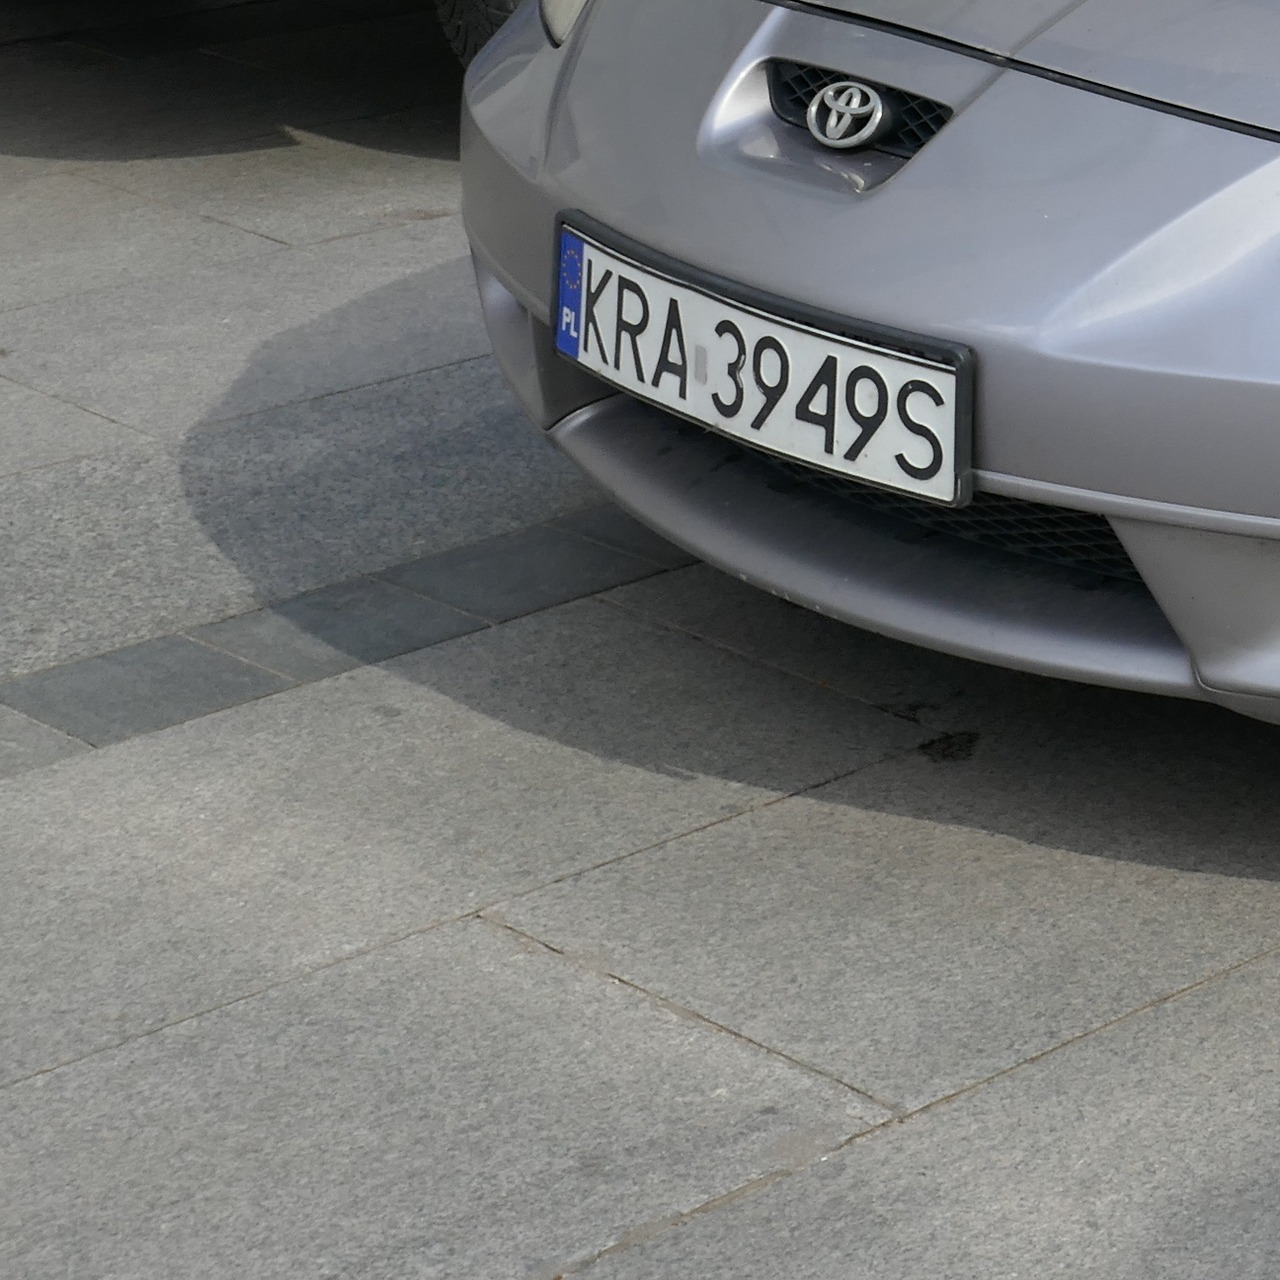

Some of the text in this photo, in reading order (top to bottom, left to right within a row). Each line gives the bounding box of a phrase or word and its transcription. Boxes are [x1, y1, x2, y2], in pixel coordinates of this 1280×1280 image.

[562, 306, 578, 338] PL
[583, 258, 945, 481] KRA 3949S
